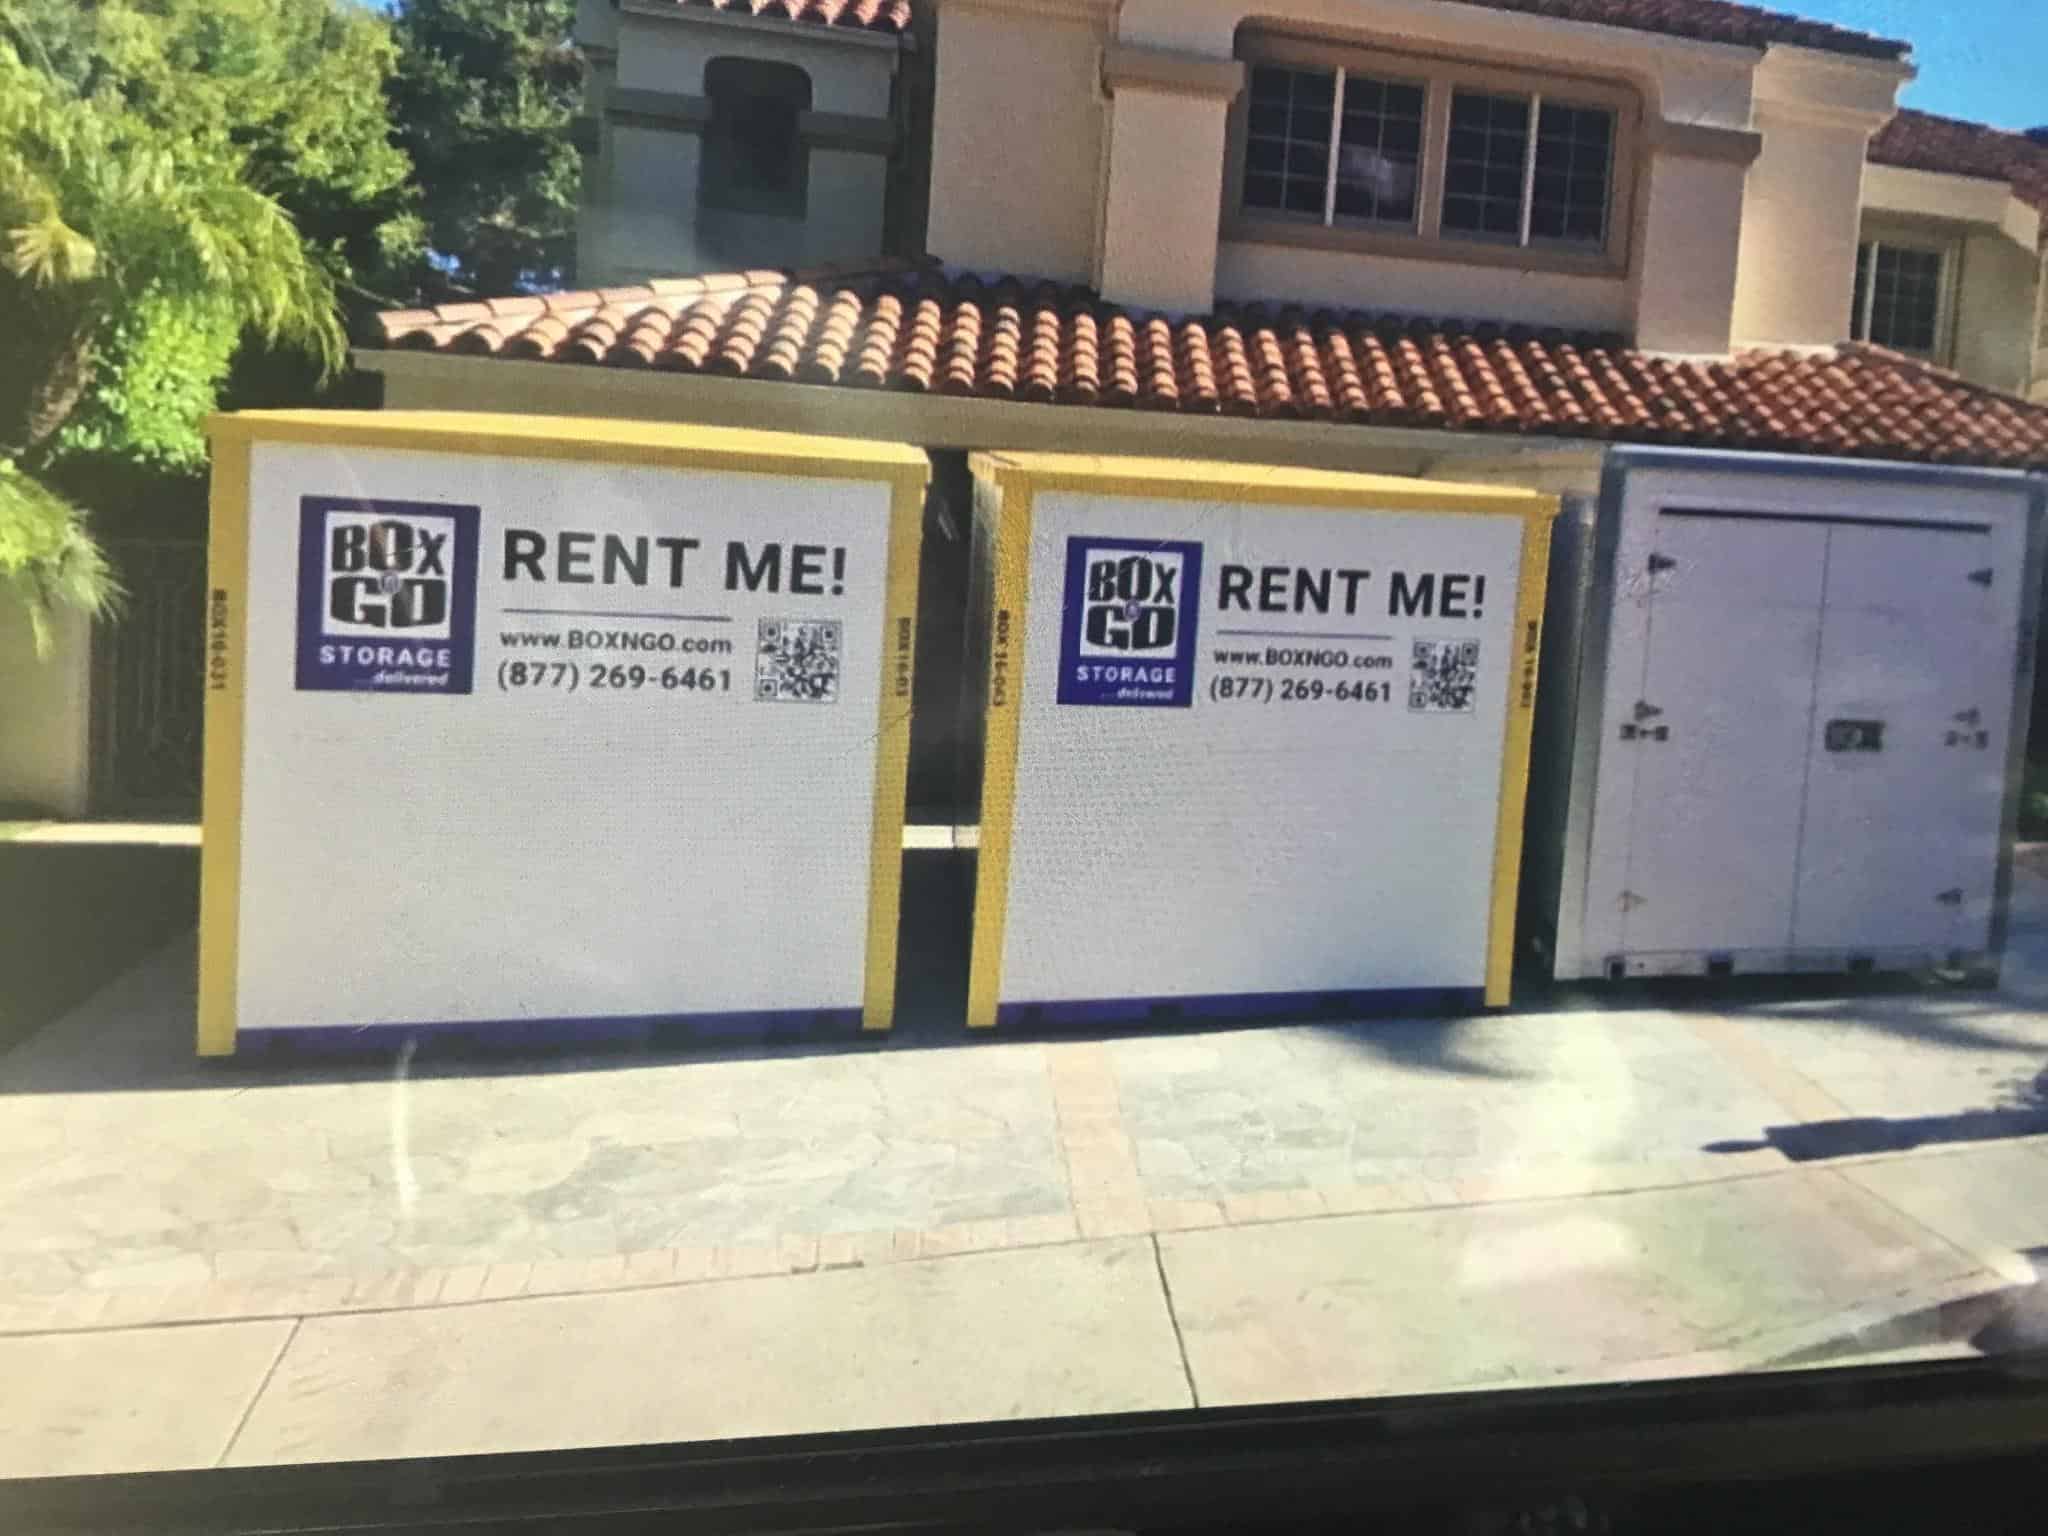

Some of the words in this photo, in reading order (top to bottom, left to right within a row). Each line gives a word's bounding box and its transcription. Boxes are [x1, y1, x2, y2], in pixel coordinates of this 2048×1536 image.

[331, 519, 448, 576] BOX
[503, 528, 701, 589] RENT
[725, 541, 847, 597] ME!
[1087, 555, 1177, 604] BOX
[1217, 564, 1371, 616] RENT
[1388, 571, 1486, 619] ME!
[330, 575, 447, 629] GO
[499, 629, 733, 655] www.BOXNGO.com
[1086, 604, 1176, 651] GO
[319, 644, 451, 669] STORAGE
[1076, 665, 1176, 684] STORAGE
[1213, 648, 1393, 669] www.BOXNGO.com
[497, 661, 580, 692] (877)
[588, 664, 732, 692] 269-6461
[1209, 676, 1273, 703] (877)
[1280, 678, 1391, 702] 269-6461
